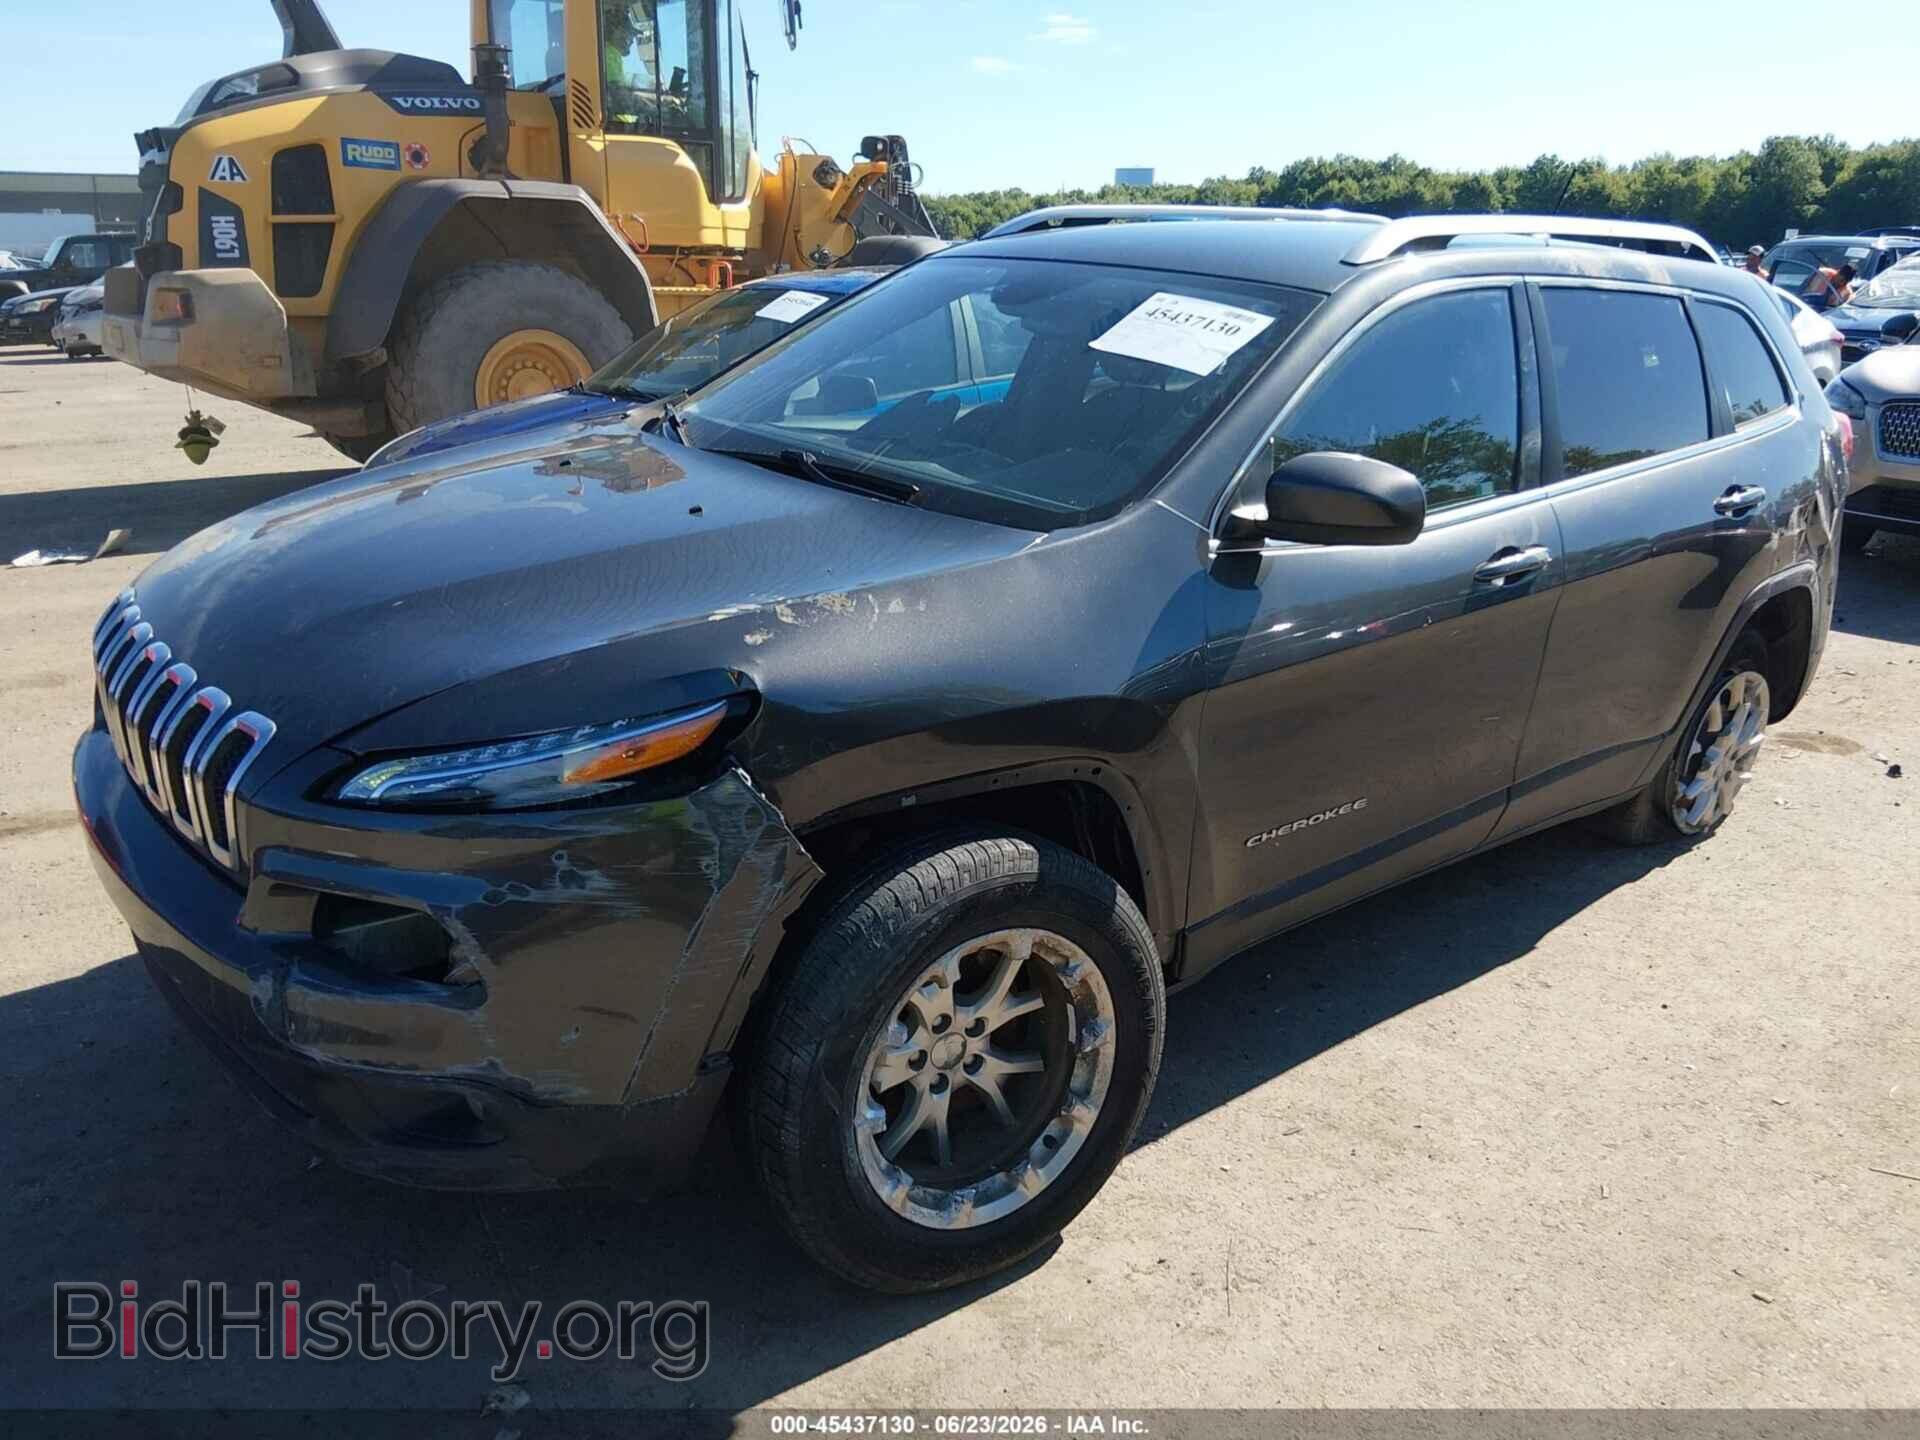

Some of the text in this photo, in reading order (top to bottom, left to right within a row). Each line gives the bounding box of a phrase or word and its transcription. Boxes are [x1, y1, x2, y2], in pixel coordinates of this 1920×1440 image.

[392, 97, 481, 109] VOLVO
[346, 143, 396, 162] RUDD
[211, 215, 241, 259] L90H
[1145, 306, 1241, 337] 45437130
[1245, 798, 1369, 848] CHEROKEE
